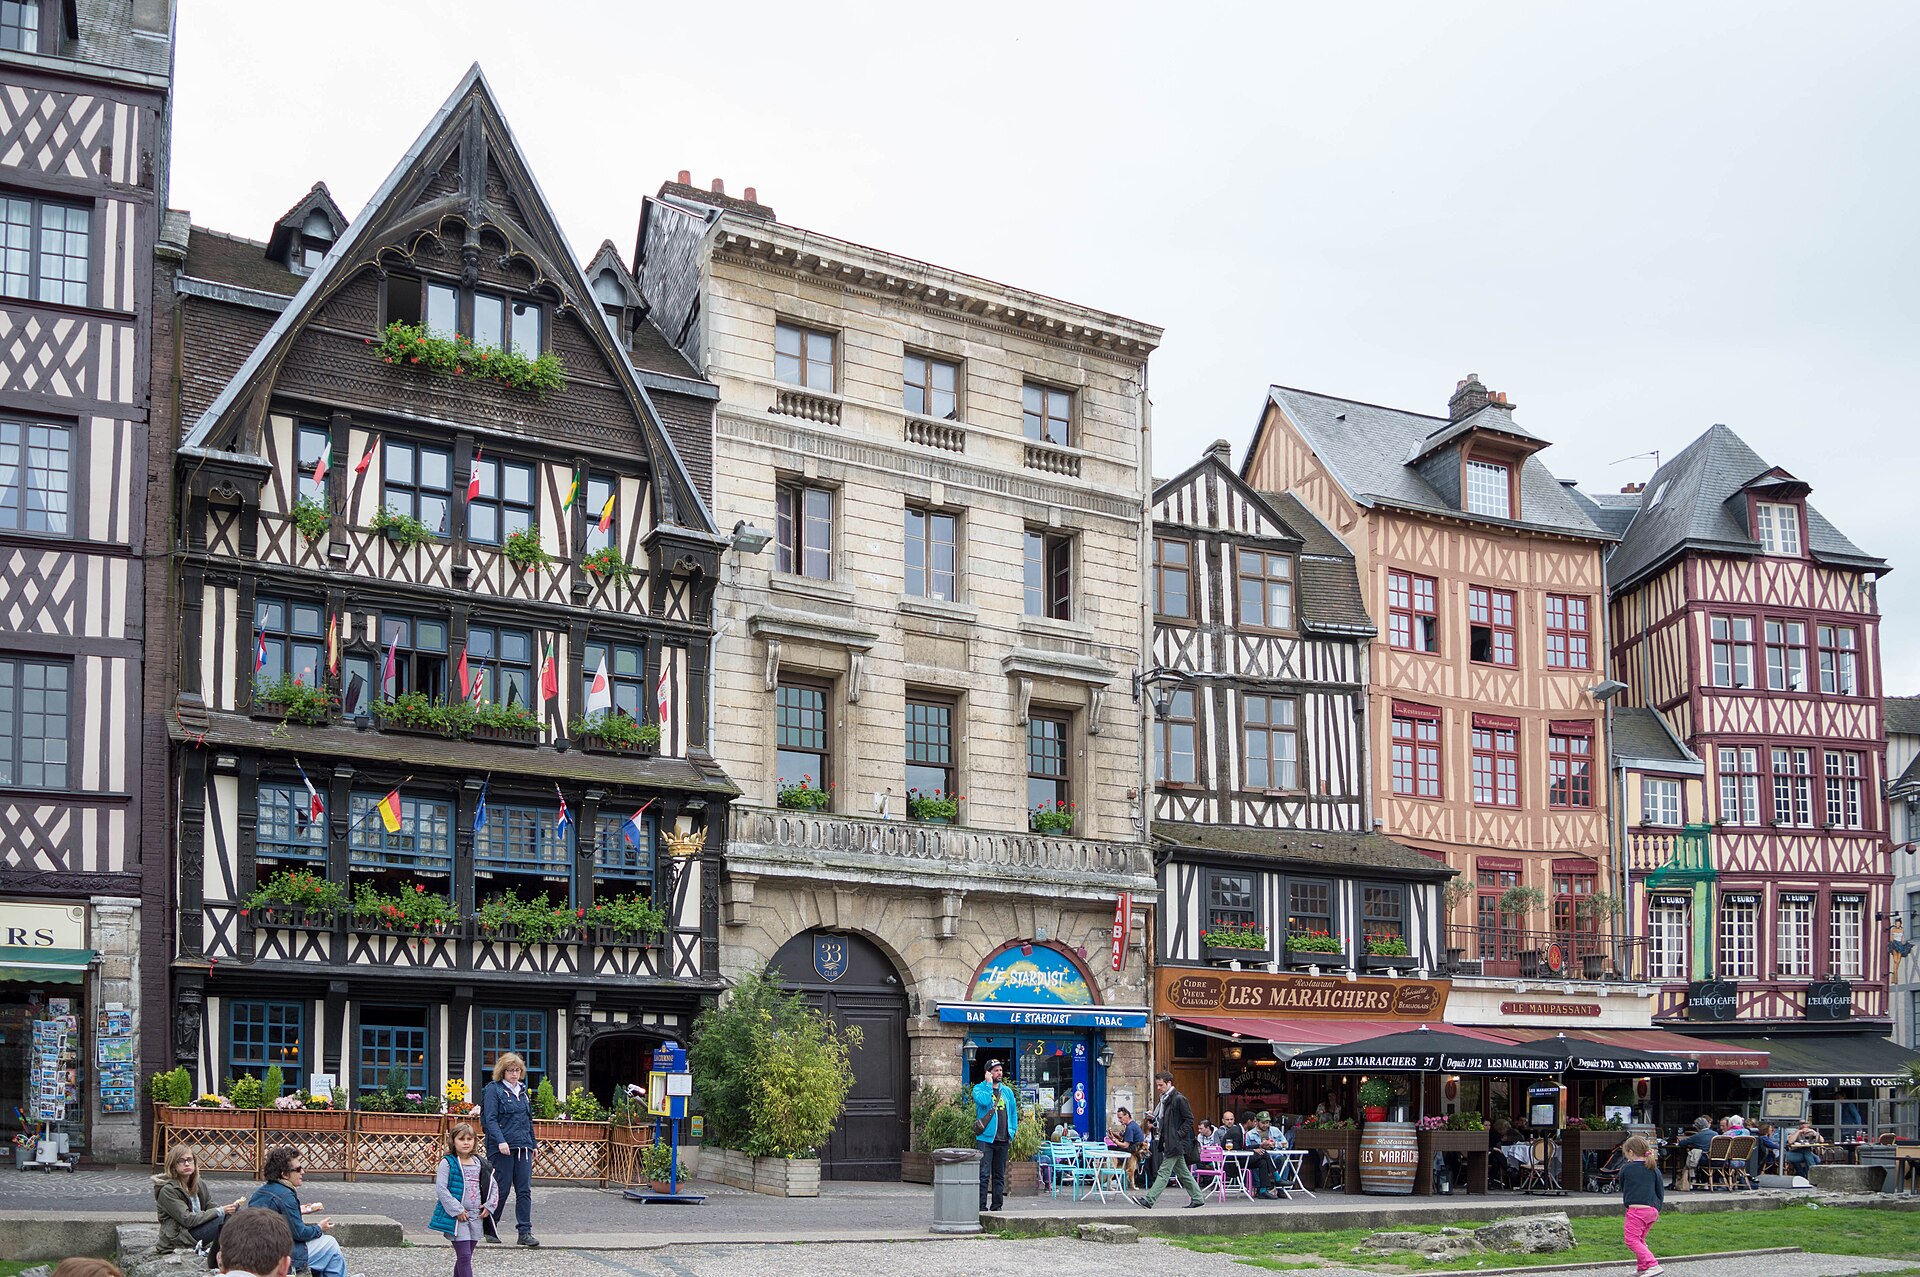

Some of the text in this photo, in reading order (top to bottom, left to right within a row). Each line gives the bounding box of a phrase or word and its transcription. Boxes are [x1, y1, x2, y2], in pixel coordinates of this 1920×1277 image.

[1660, 896, 1685, 904] L'EURO
[1731, 895, 1755, 903] L'EURO
[1112, 895, 1123, 968] TABAC
[821, 943, 842, 963] 33
[988, 965, 1066, 988] LE STARDUST
[1294, 979, 1336, 988] Restaurant
[1228, 985, 1391, 1009] LES MARAICHERS
[1689, 996, 1717, 1006] L'EURO
[1808, 996, 1834, 1006] L'EURO
[1512, 1003, 1592, 1015] LE MAUPASSANT
[967, 1012, 985, 1022] BAR
[1010, 1012, 1072, 1025] LE STARDUST
[1094, 1016, 1123, 1027] TABAC
[1034, 1039, 1045, 1056] 3
[1290, 1057, 1434, 1070] Depuis 1912 LES MARAICHERS 37
[1447, 1057, 1563, 1070] Depuis 1912 LES MARAICHERS 37
[1577, 1058, 1600, 1069] Depuis
[1600, 1059, 1615, 1069] 1912
[1618, 1060, 1633, 1069] LES
[1633, 1060, 1682, 1070] MARAICHERS
[1231, 1071, 1255, 1091] BISTROT
[1798, 1078, 1829, 1087] 'EURO
[1839, 1078, 1862, 1086] BARS
[1361, 1150, 1374, 1163] LES
